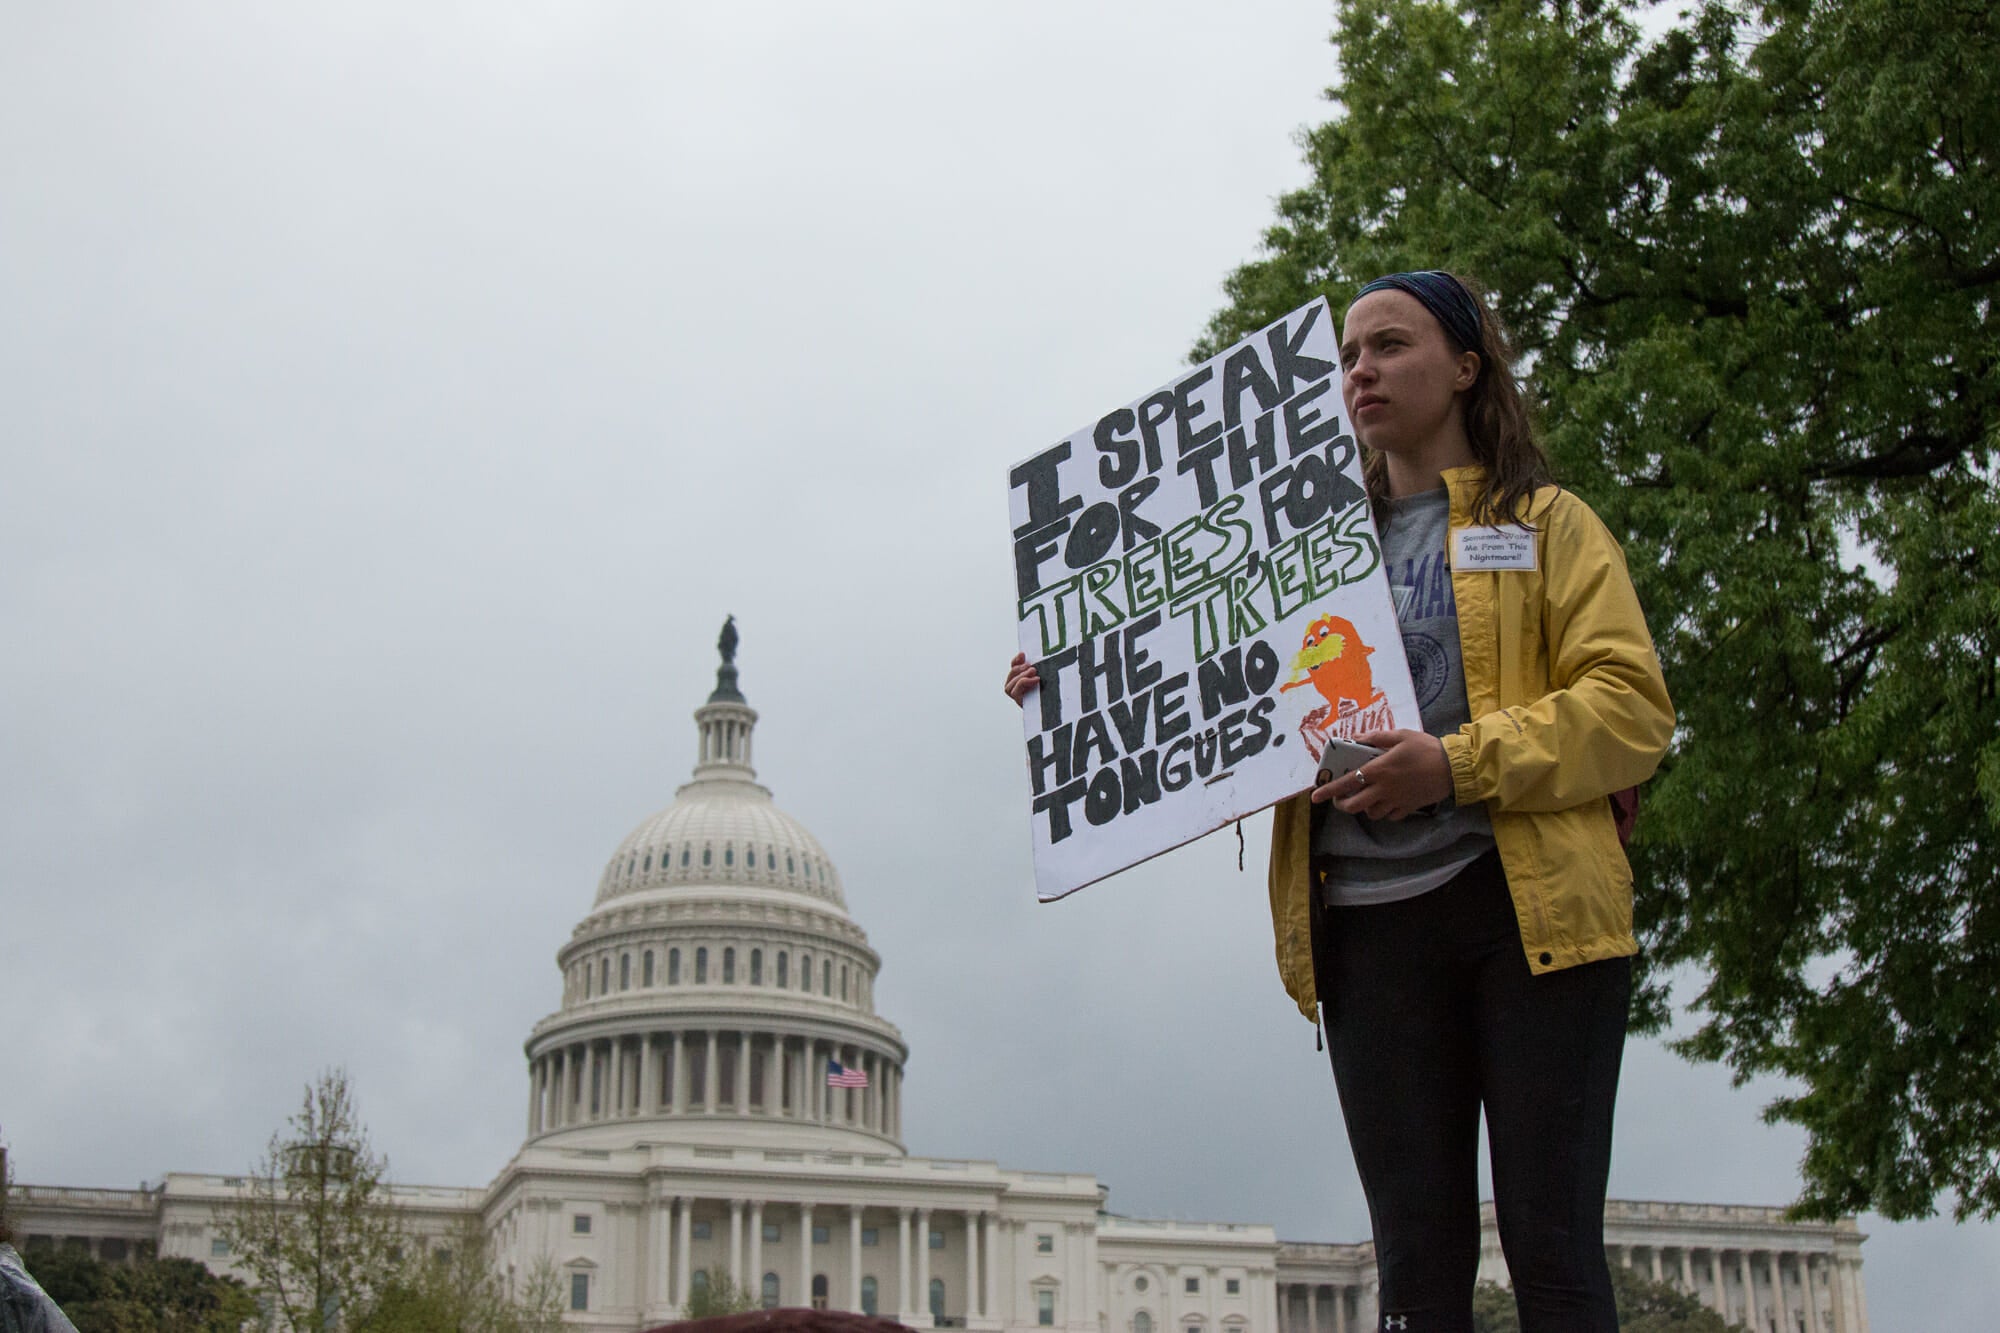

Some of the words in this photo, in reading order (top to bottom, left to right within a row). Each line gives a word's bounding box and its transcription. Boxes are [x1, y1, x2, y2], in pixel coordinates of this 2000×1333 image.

[1010, 441, 1084, 540] I
[1094, 304, 1337, 489] SPEAK
[1014, 477, 1162, 599] FOR
[1177, 379, 1340, 509] THE
[1259, 435, 1368, 549] FOR
[1034, 610, 1162, 731] THE
[1170, 499, 1381, 663] TREES
[1481, 543, 1505, 551] From
[1509, 542, 1528, 550] This
[1027, 672, 1190, 796] HAVE
[1198, 640, 1280, 720] NO
[1033, 696, 1287, 844] TONGUES.
